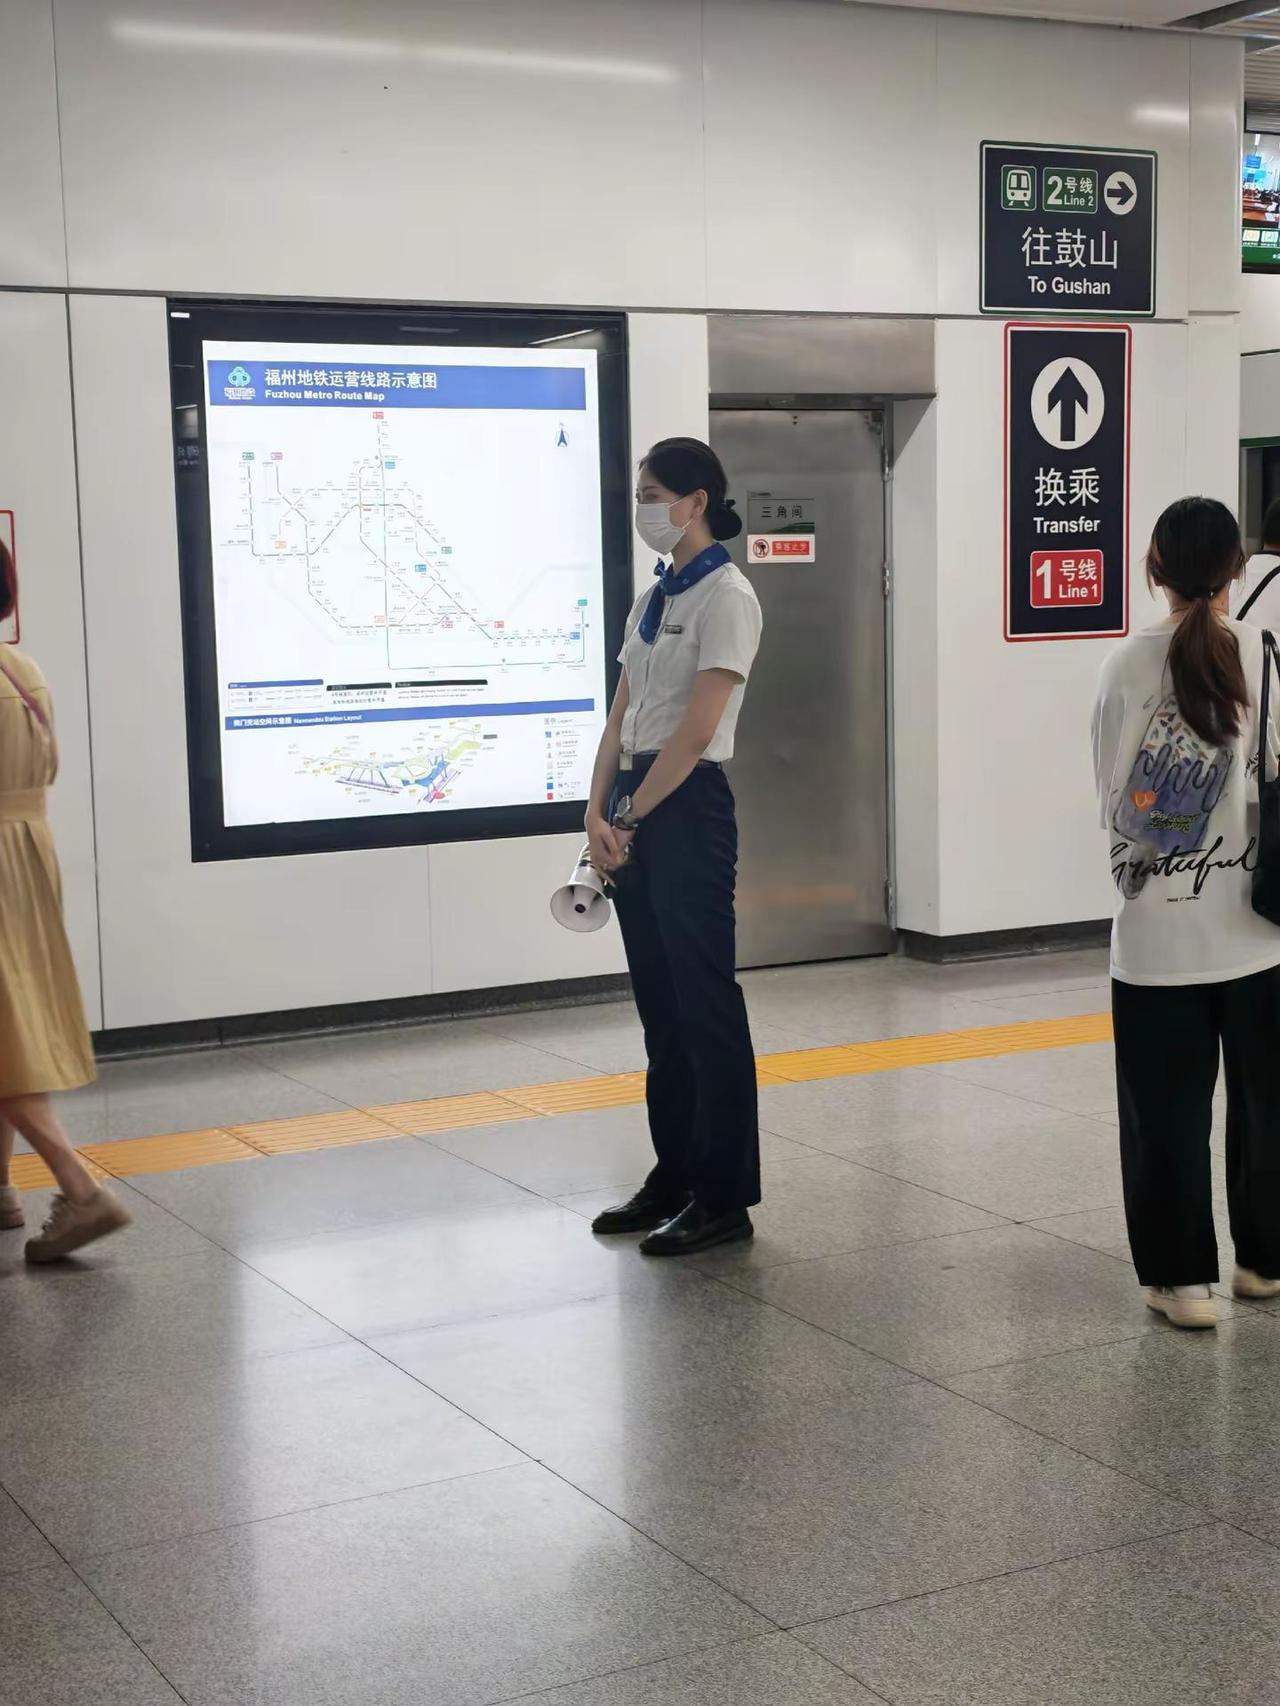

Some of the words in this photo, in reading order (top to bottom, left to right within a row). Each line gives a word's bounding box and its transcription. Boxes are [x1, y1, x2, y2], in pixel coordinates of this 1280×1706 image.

[1064, 195, 1086, 206] Line
[1088, 196, 1094, 206] 2
[1021, 226, 1118, 269] 往鼓山
[1028, 276, 1047, 293] To
[1052, 276, 1111, 295] Gushan
[264, 369, 438, 389] 福州地铁运营线路示意图
[265, 391, 302, 399] Fuzhou
[304, 391, 333, 400] Metro
[334, 391, 363, 400] Route
[364, 392, 385, 402] Map
[1034, 467, 1100, 507] 换乘
[1033, 516, 1100, 534] Transfer
[1059, 584, 1089, 598] Line
[1092, 584, 1098, 597] 1
